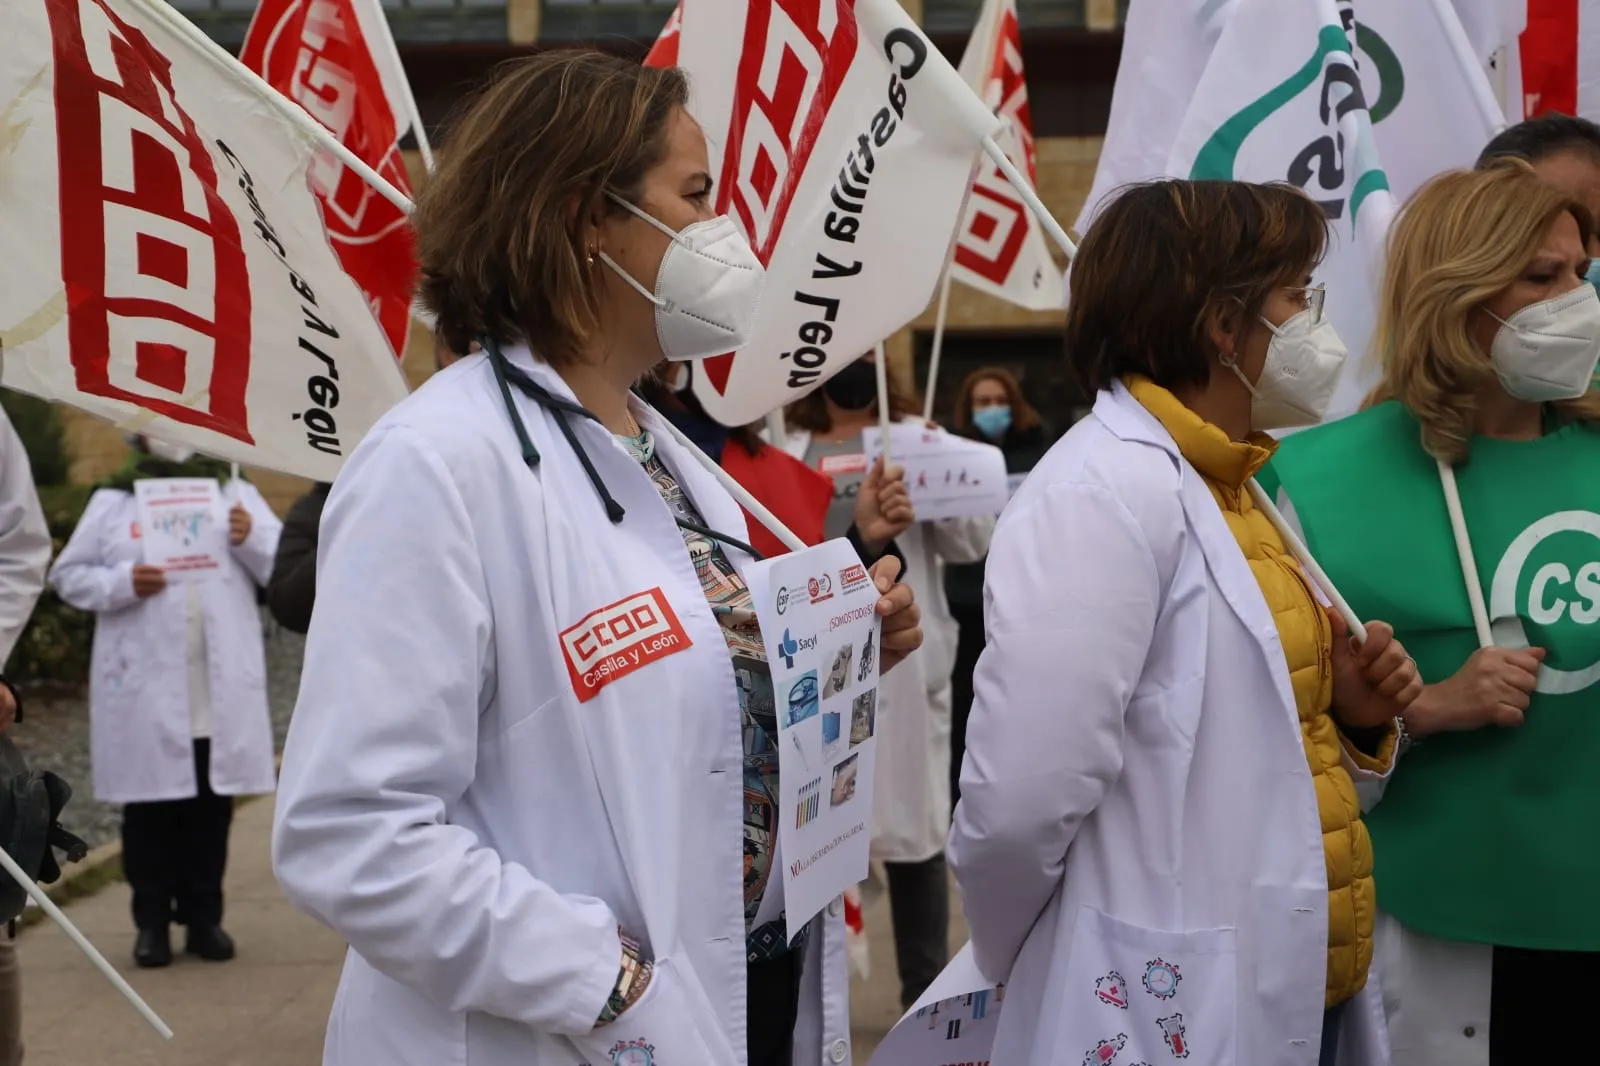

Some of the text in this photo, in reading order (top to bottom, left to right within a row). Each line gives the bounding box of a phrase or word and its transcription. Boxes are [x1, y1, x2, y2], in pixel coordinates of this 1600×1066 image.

[573, 604, 658, 662] CCOO
[629, 648, 640, 665] y
[641, 633, 680, 655] León
[799, 634, 818, 651] Sacyl
